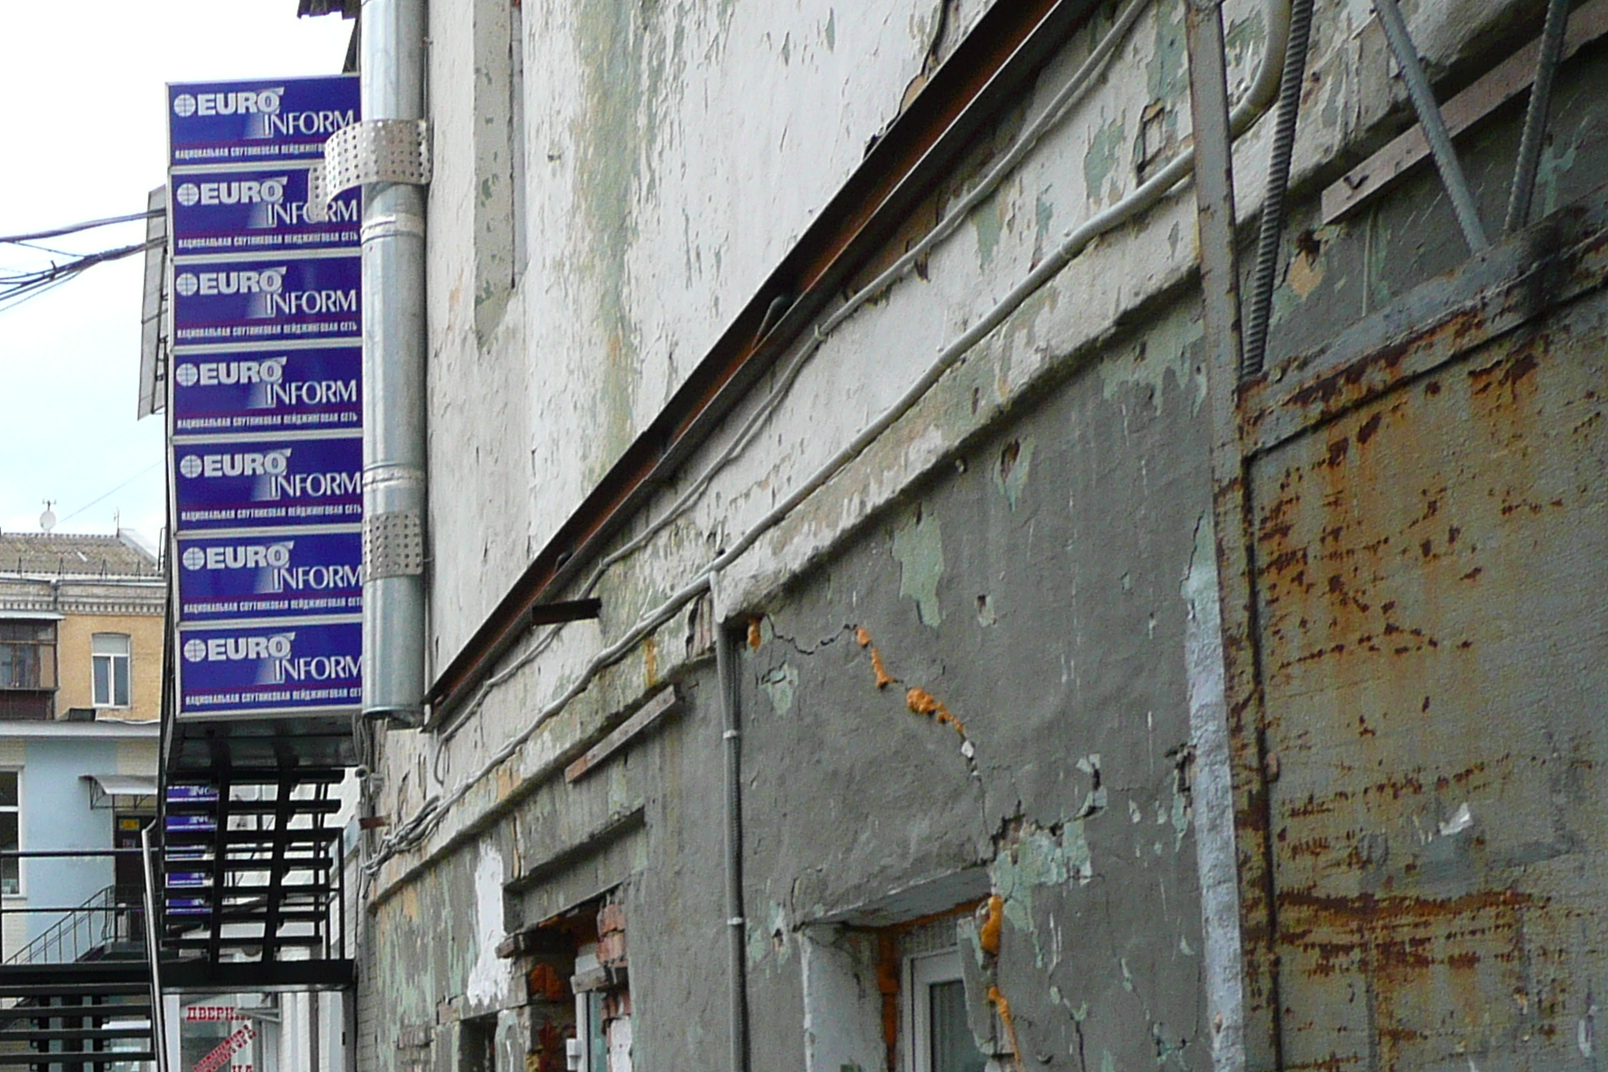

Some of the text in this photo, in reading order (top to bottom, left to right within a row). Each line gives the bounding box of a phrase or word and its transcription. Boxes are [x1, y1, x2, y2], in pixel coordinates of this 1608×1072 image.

[197, 91, 280, 116] EURO
[264, 110, 355, 136] INFORM
[200, 180, 284, 205] EURO
[199, 270, 283, 295] EURO
[265, 289, 357, 315] INFORM
[199, 360, 283, 386] EURO
[265, 379, 357, 405] INFORM
[203, 452, 287, 477] EURO
[270, 472, 361, 498] INFORM
[206, 544, 289, 569] EURO
[273, 565, 363, 590] INFORM
[207, 636, 291, 661] EURO
[274, 655, 362, 682] INFORM
